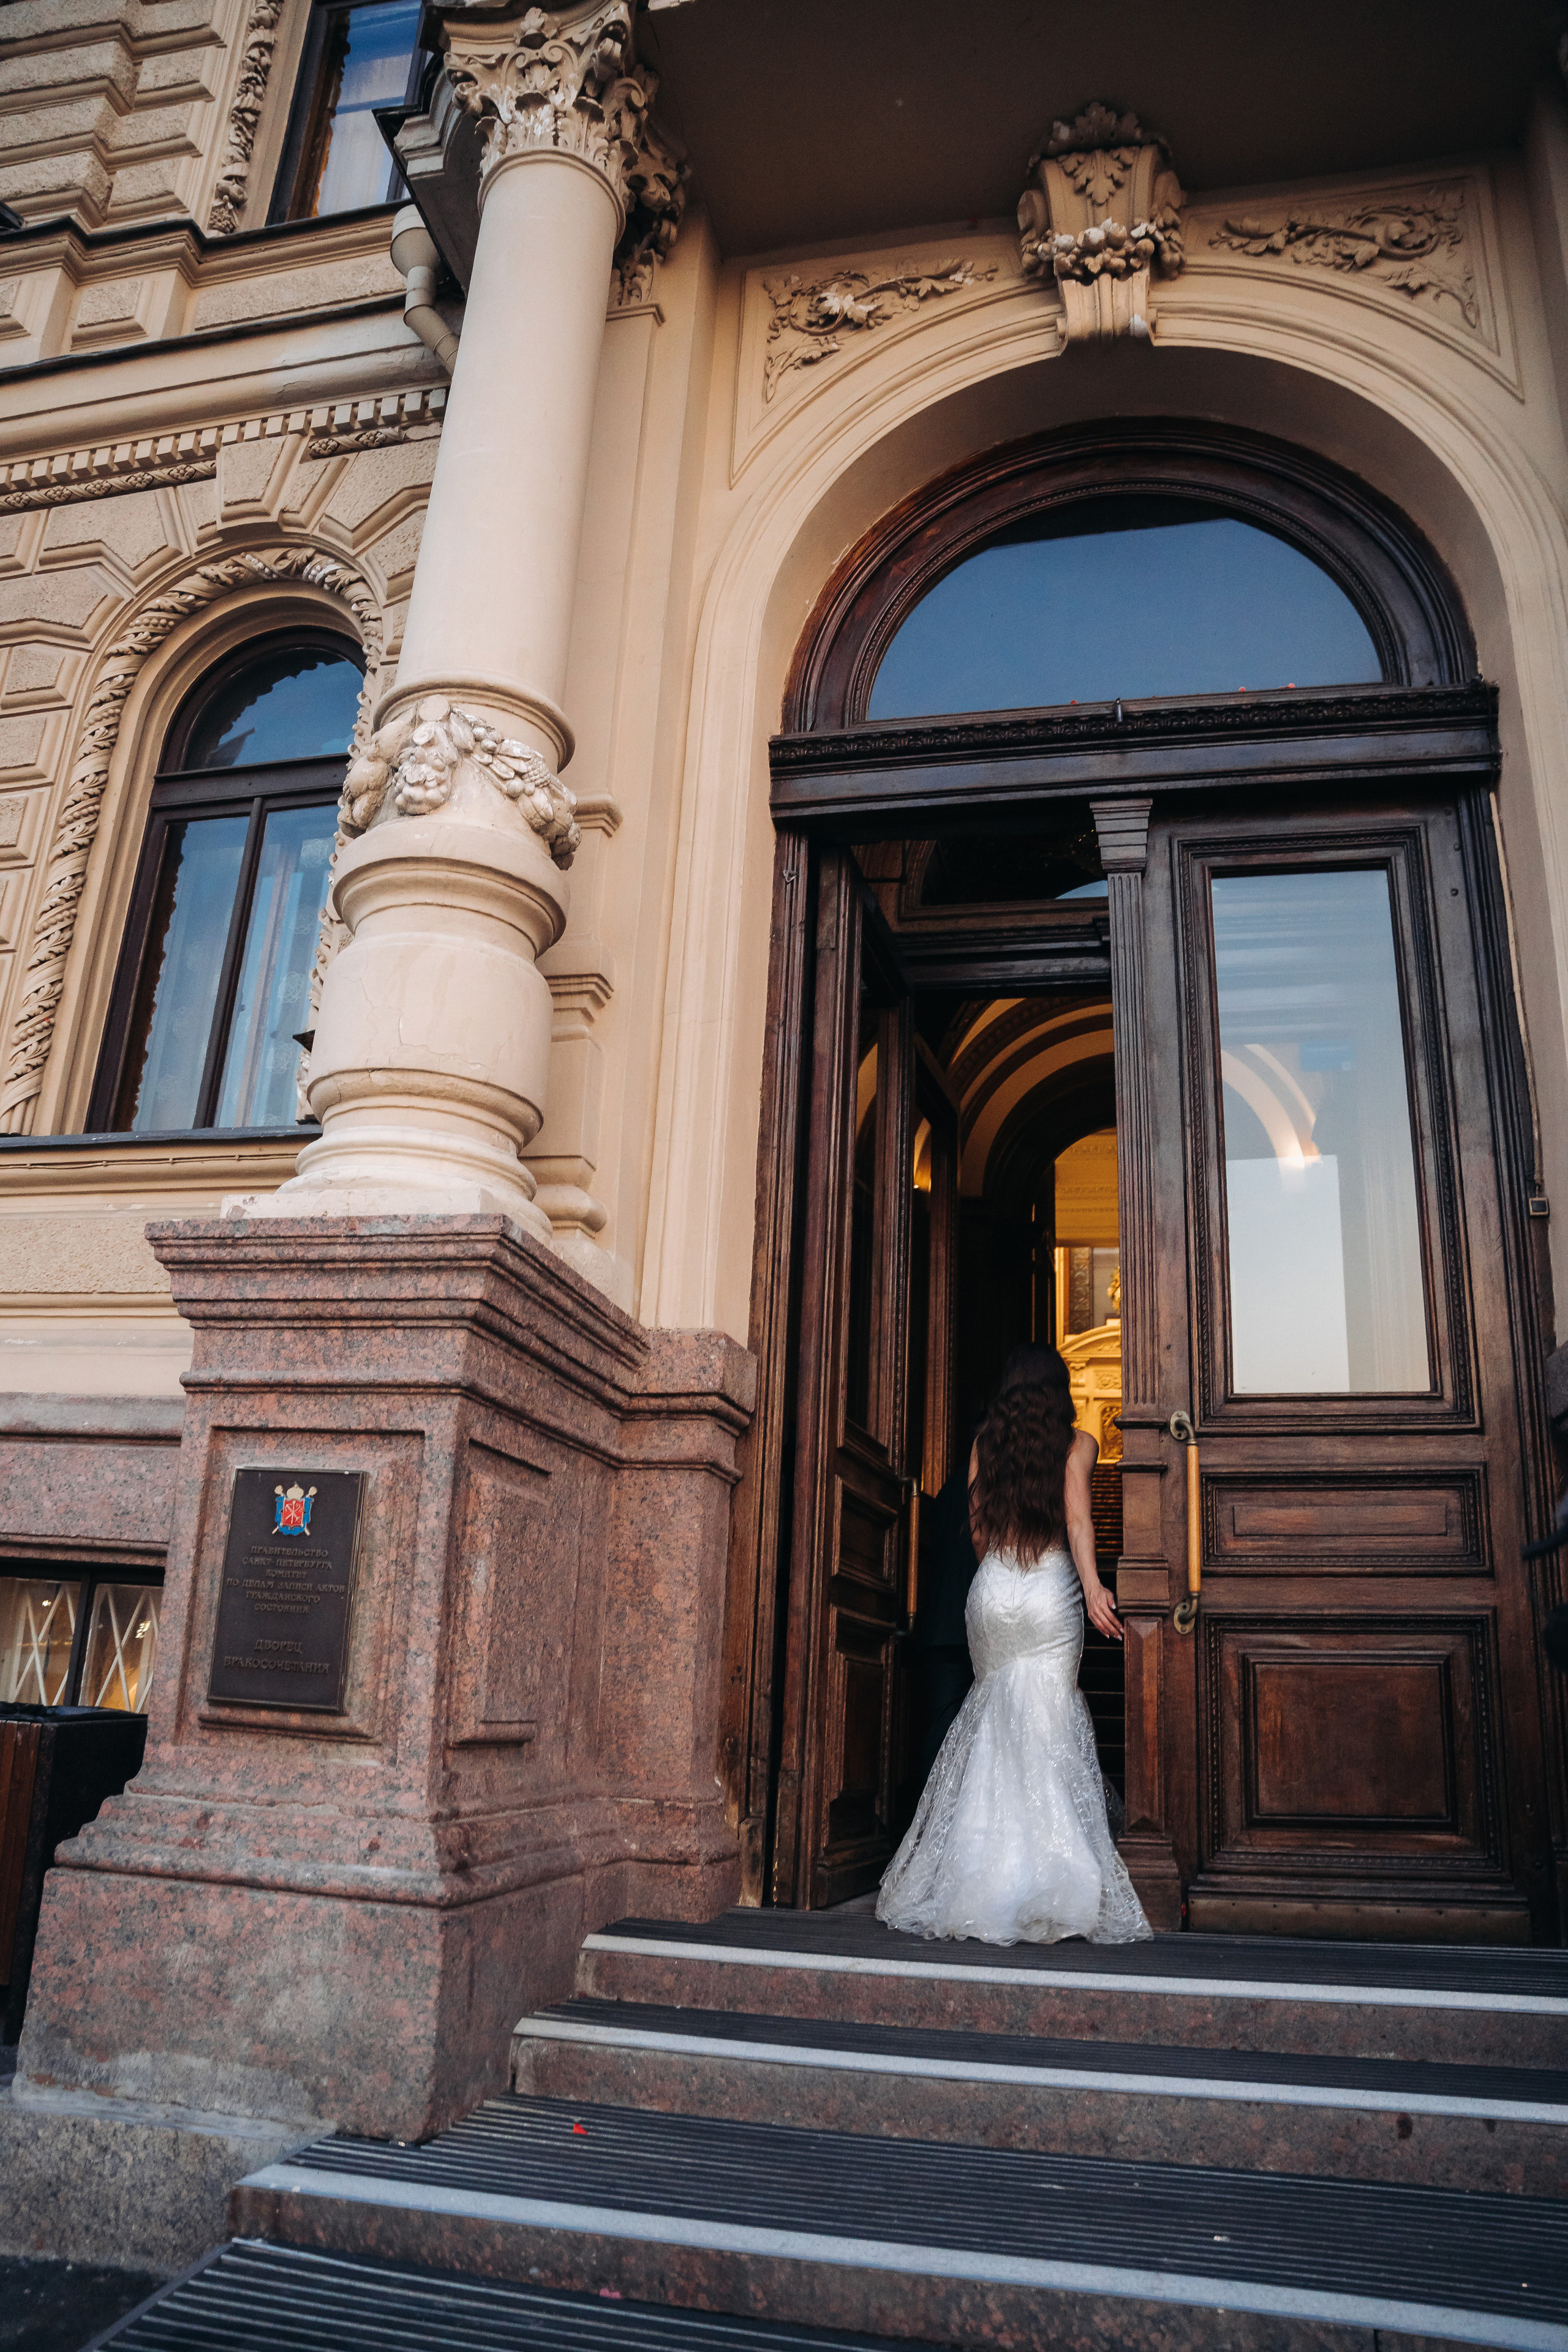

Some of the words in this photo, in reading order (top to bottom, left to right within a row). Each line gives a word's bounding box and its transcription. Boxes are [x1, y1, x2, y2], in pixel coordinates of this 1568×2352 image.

[251, 1545, 328, 1557] ПРАВИТЕЛЬСТВО
[265, 1569, 307, 1579] КОМИТЕТ
[227, 1578, 239, 1586] ПО
[242, 1578, 274, 1589] ДЕЛАМ
[277, 1581, 312, 1591] ЗАПИСИ
[317, 1584, 345, 1593] АКТОВ
[246, 1591, 320, 1604] ГРАЖДАНСКОГО
[254, 1603, 310, 1613] СОСТОЯНИЯ
[254, 1638, 303, 1654] ДВОРЕЦ
[224, 1656, 330, 1673] БРАКОСОЧЕТАНИЯ
